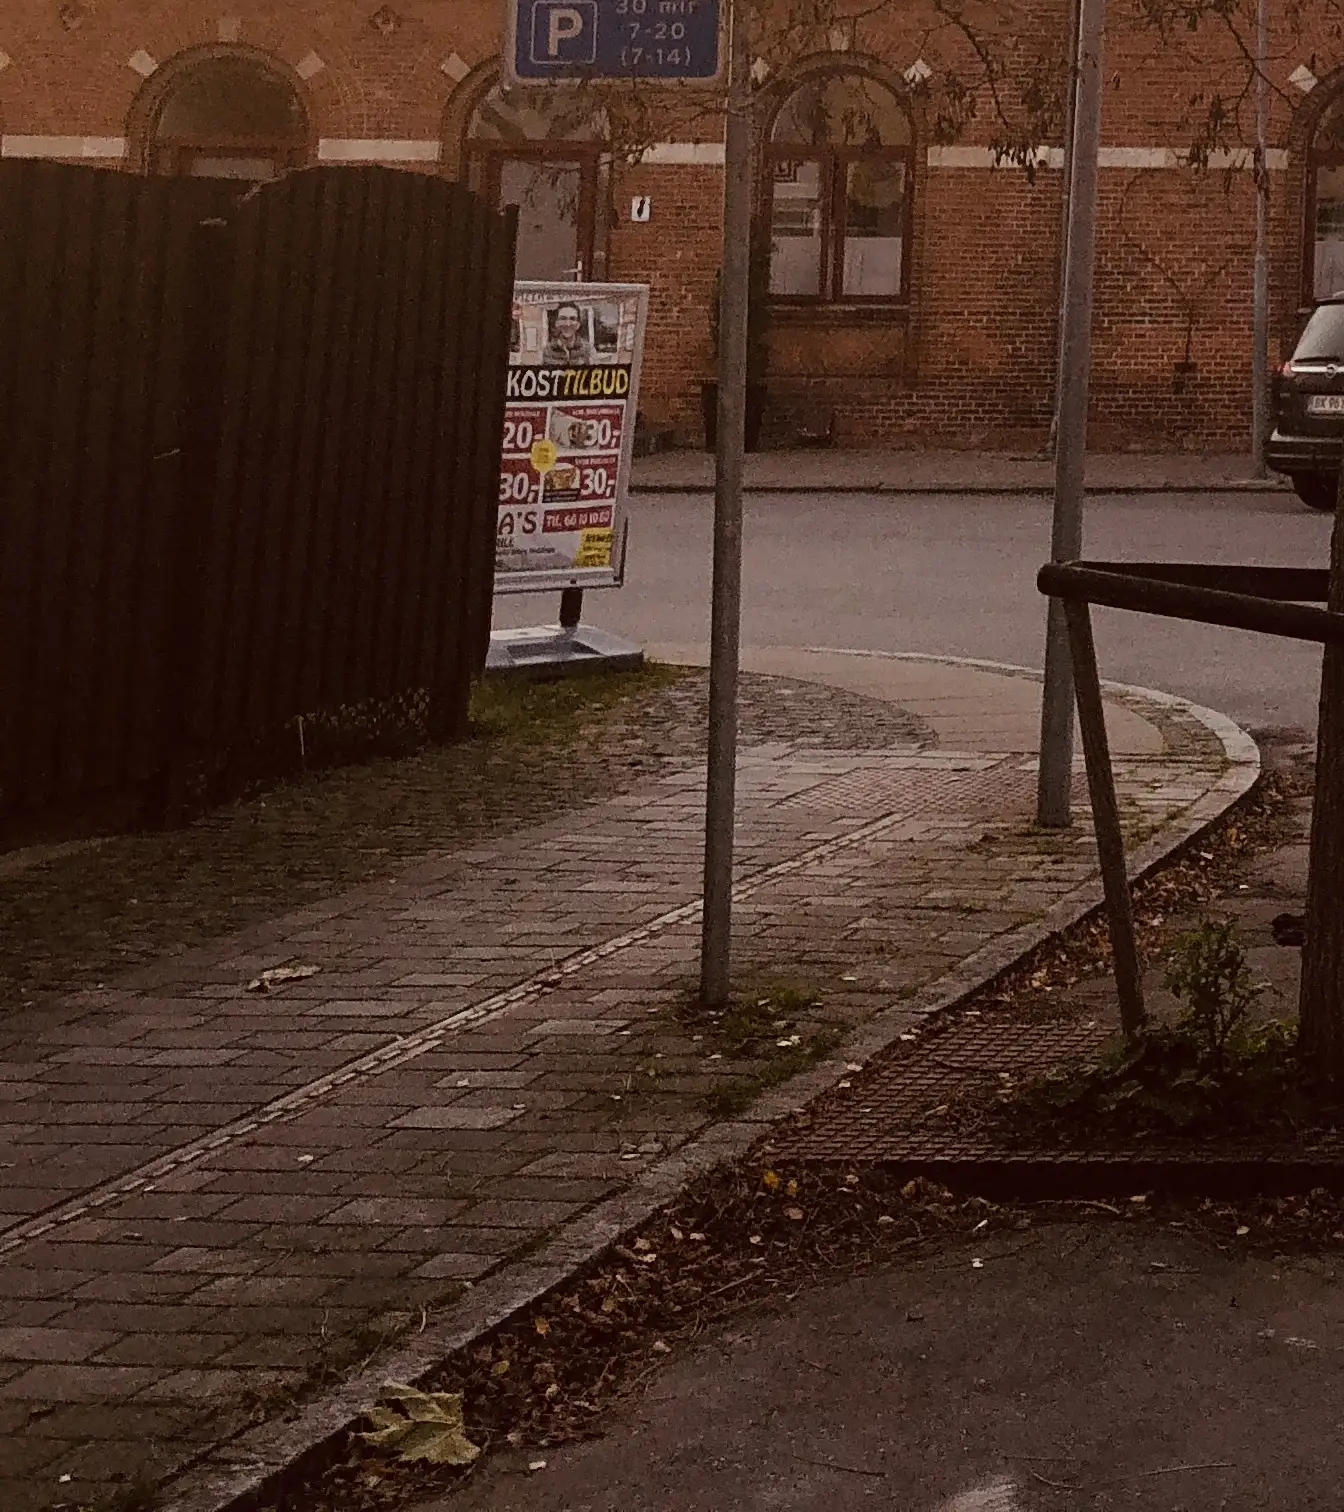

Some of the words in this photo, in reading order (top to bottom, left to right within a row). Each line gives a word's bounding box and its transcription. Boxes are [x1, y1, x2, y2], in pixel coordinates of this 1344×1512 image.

[548, 8, 583, 56] P
[629, 22, 685, 40] 7-20
[620, 46, 691, 67] (7-14)
